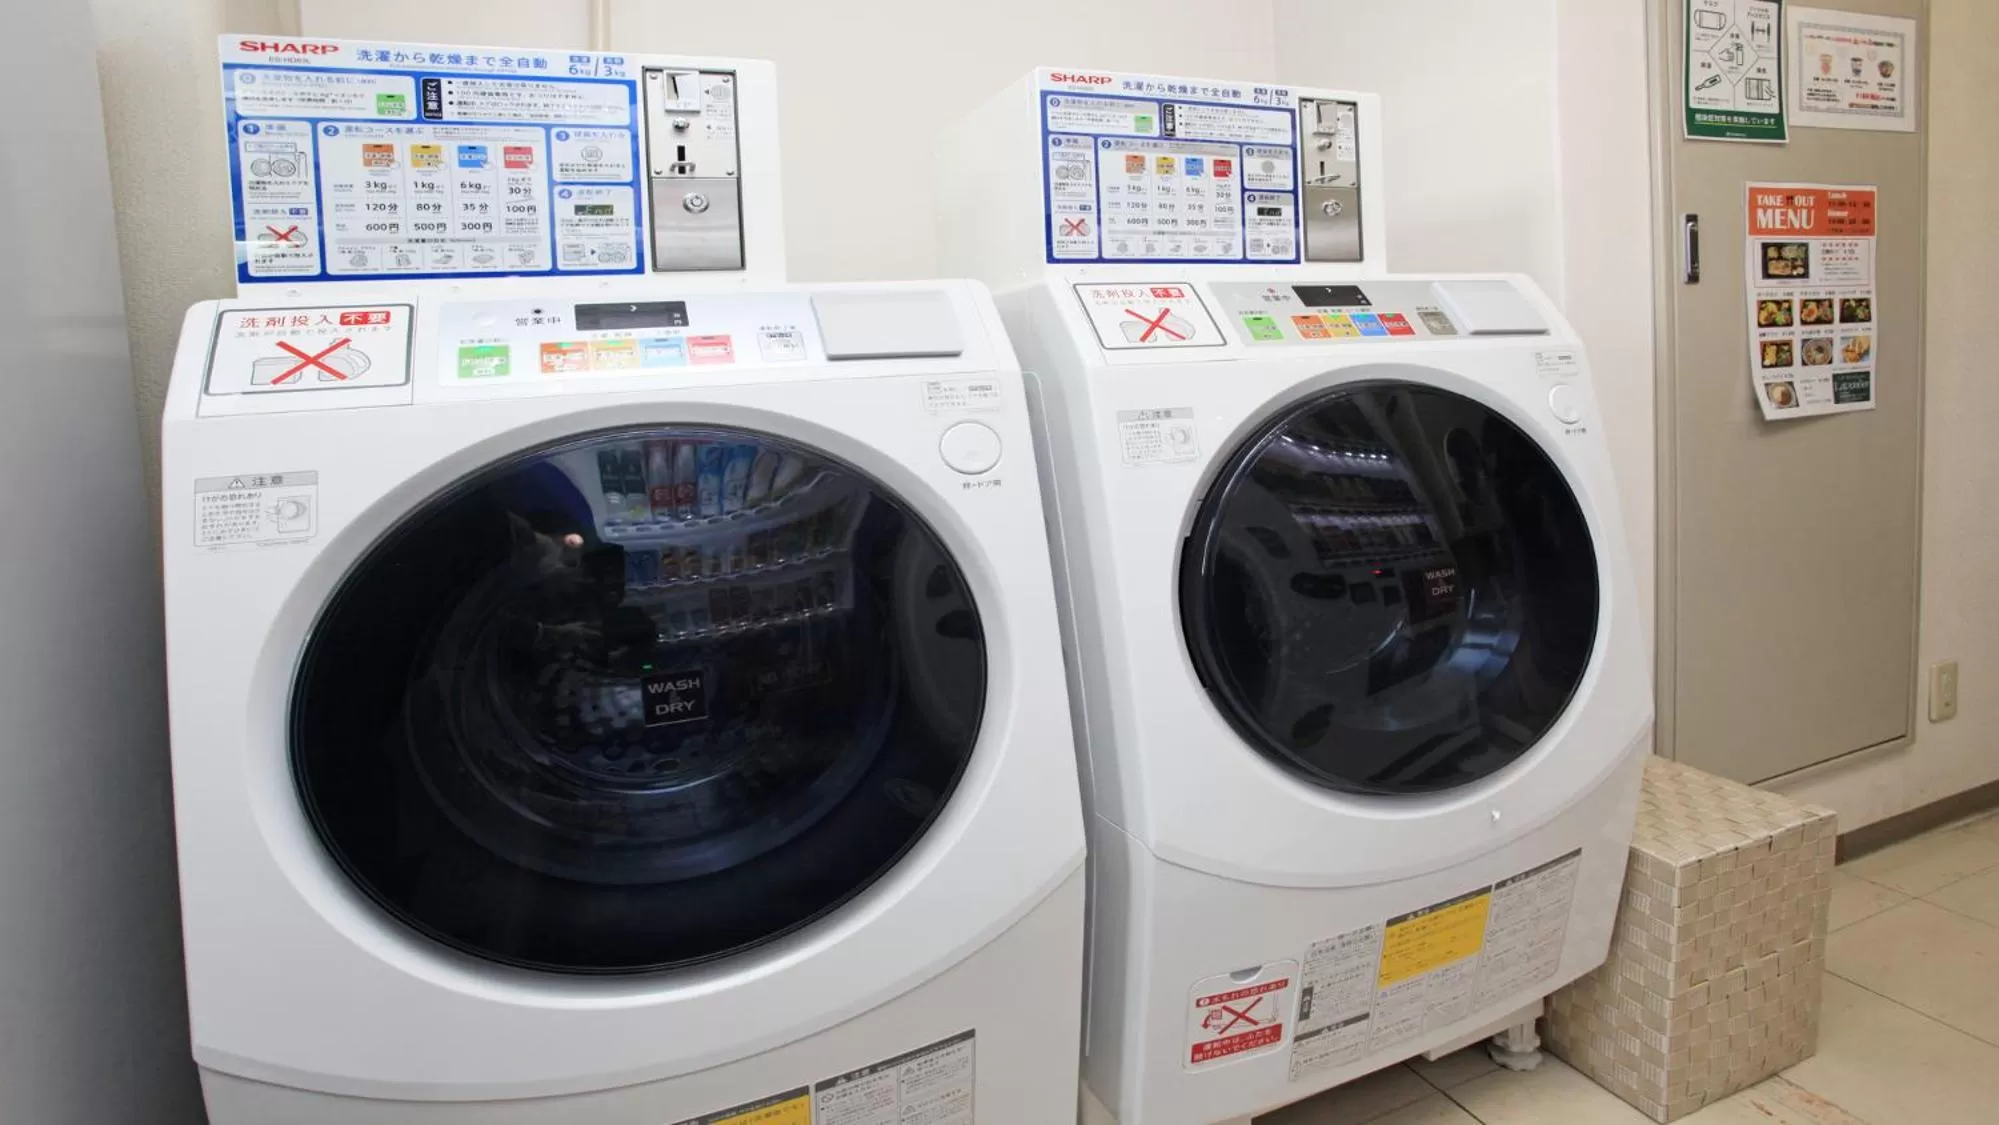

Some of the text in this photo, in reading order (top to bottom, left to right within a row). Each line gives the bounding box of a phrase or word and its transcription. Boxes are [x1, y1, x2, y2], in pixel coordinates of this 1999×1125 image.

[239, 40, 339, 55] SHARP
[356, 48, 548, 70] 洗濯から乾燥まで全自動
[1050, 73, 1112, 84] SHARP
[1122, 80, 1241, 98] 洗濯から乾燥まで全自動
[1756, 195, 1815, 206] TAKE OUT
[1757, 208, 1815, 229] MENU
[365, 223, 399, 232] 600円
[413, 223, 447, 232] 500円
[460, 222, 492, 232] 300円
[240, 312, 389, 329] 洗剤投入 不要
[1424, 568, 1456, 580] WASH
[1432, 584, 1456, 596] DRY
[648, 678, 700, 694] WASH
[656, 700, 696, 715] DRY
